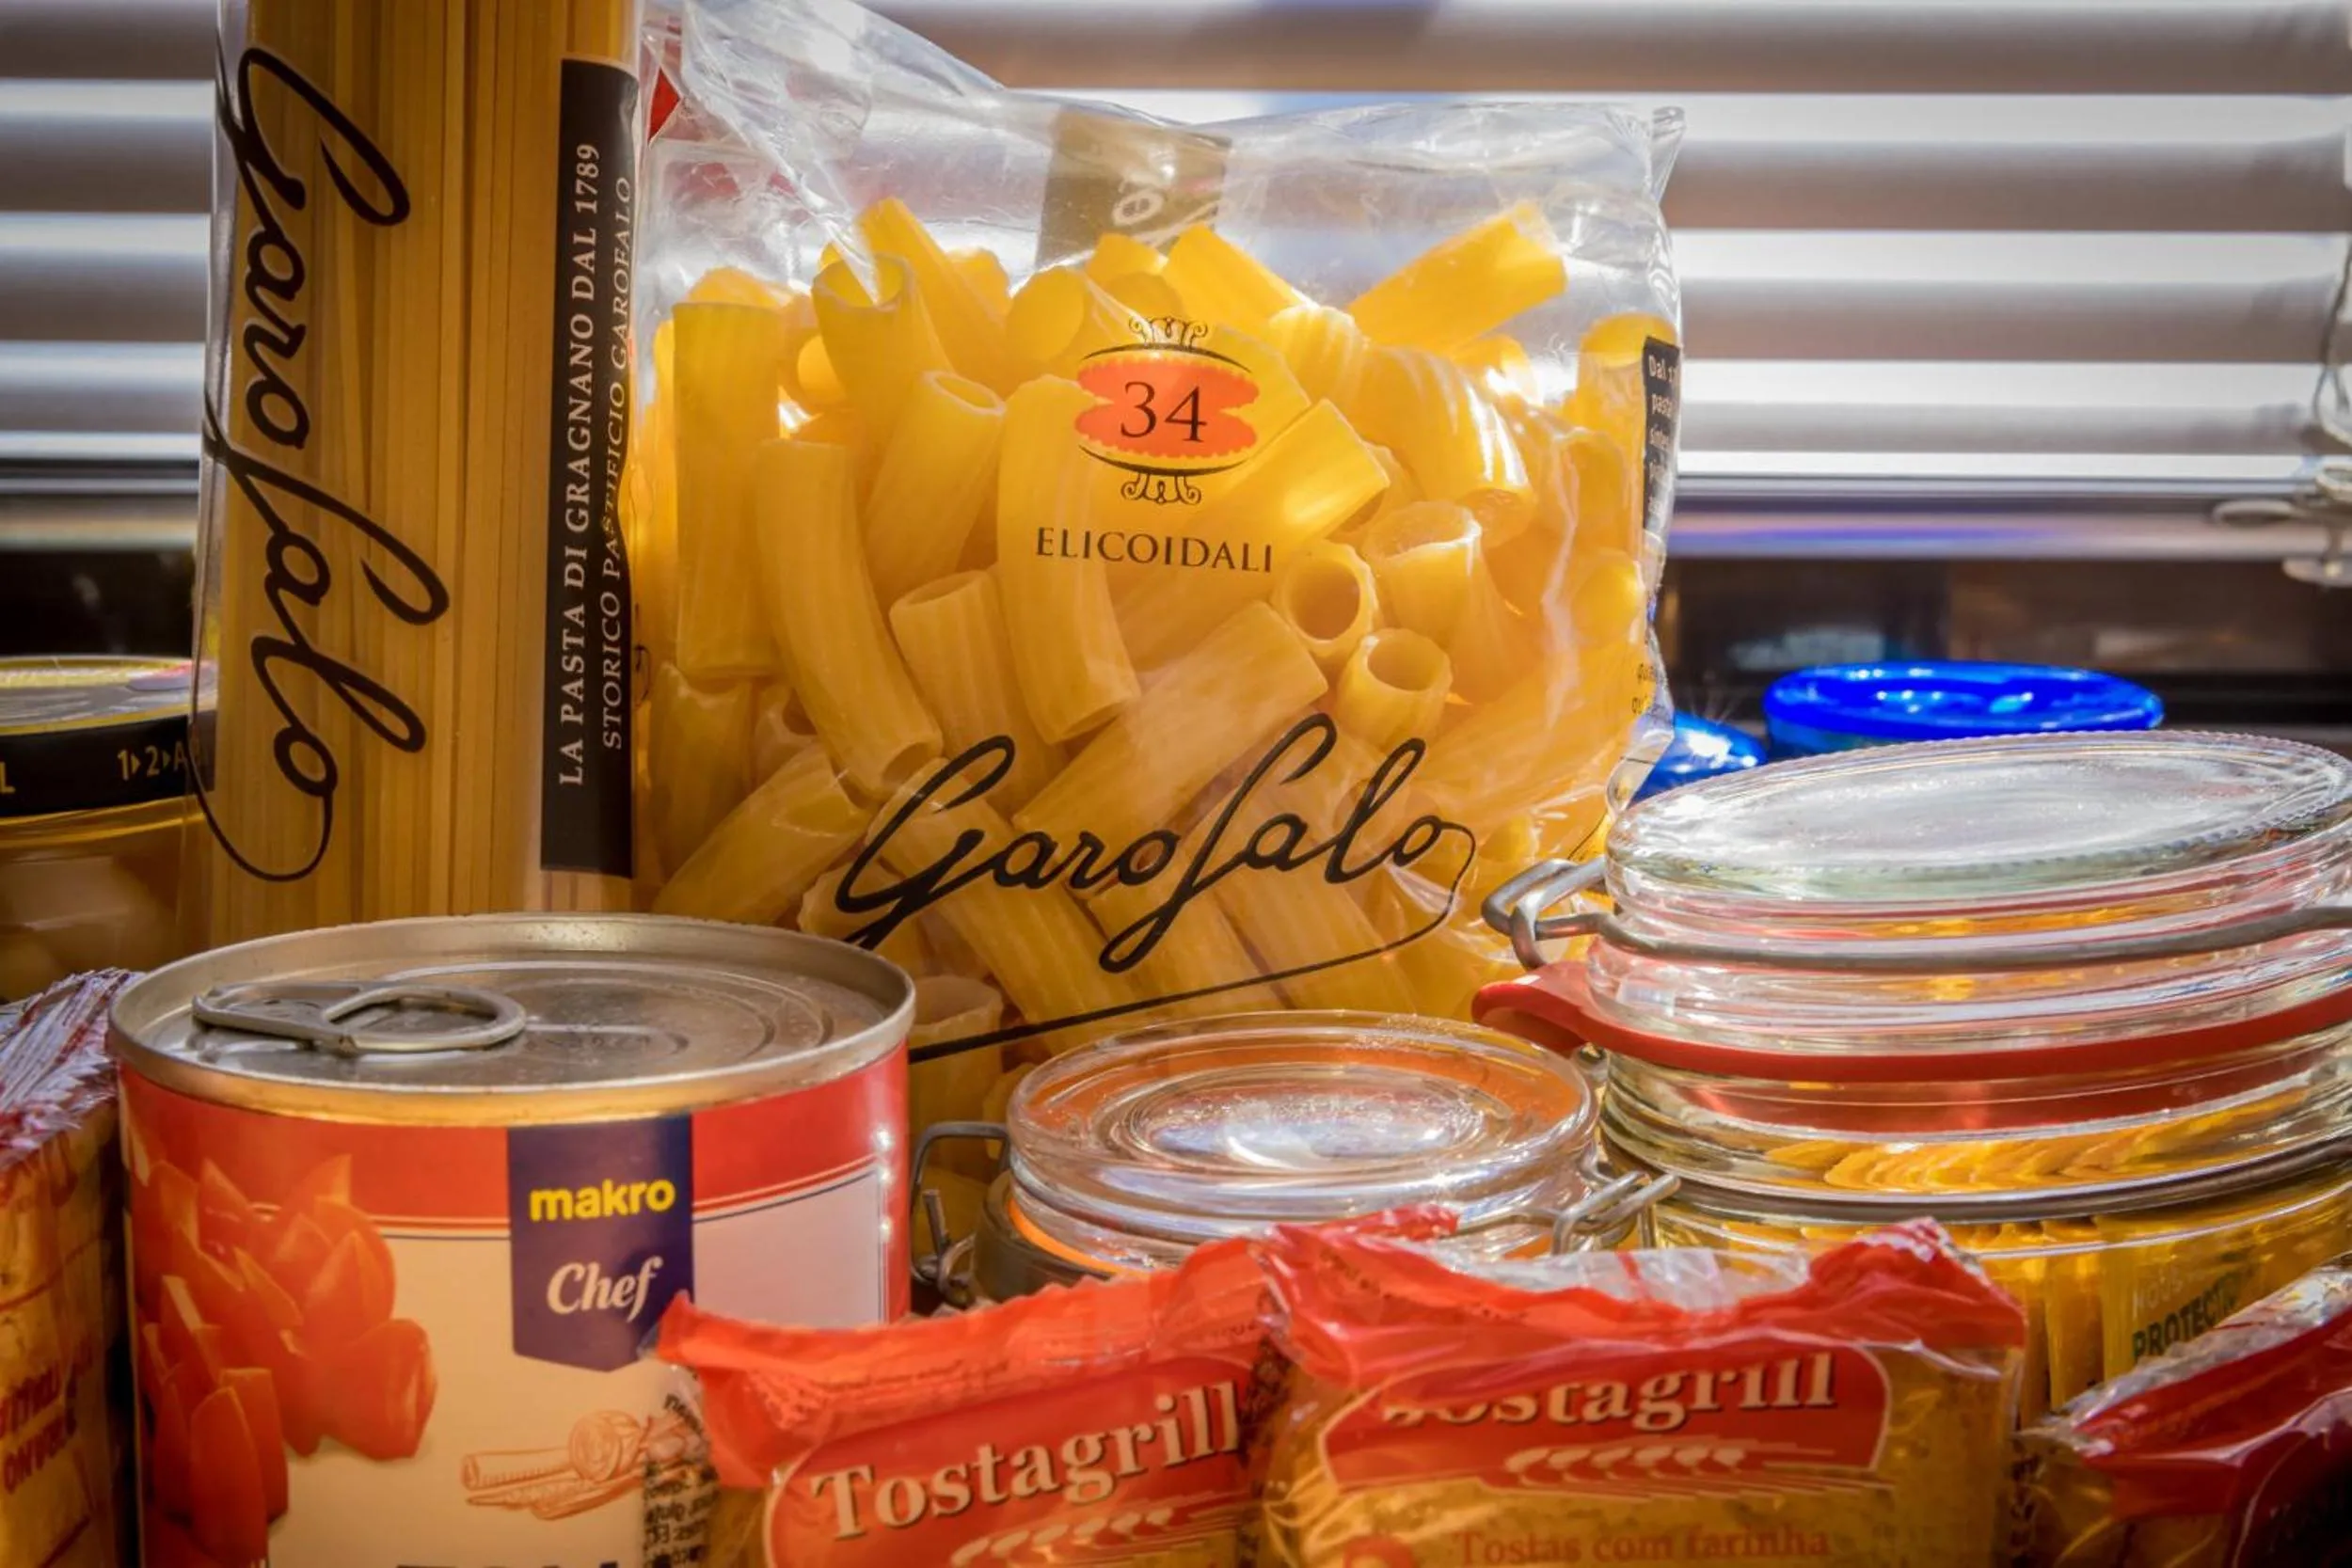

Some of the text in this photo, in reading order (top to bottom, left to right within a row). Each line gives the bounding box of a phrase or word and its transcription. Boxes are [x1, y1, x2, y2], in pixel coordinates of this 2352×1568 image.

[201, 28, 450, 882] Garofalo
[558, 143, 600, 787] LA PASTA DI GRAGNANO DAL 1789
[599, 176, 632, 751] STORICO PASTIFICIO GAROFALO
[1120, 381, 1208, 443] 34
[1036, 526, 1272, 573] ELICOIDALI
[834, 711, 1475, 974] Garofalo
[530, 1179, 675, 1222] makro
[546, 1257, 664, 1323] Chef
[810, 1380, 1242, 1544] Tostagrill
[1453, 1521, 1829, 1568] Tostas com farinha
